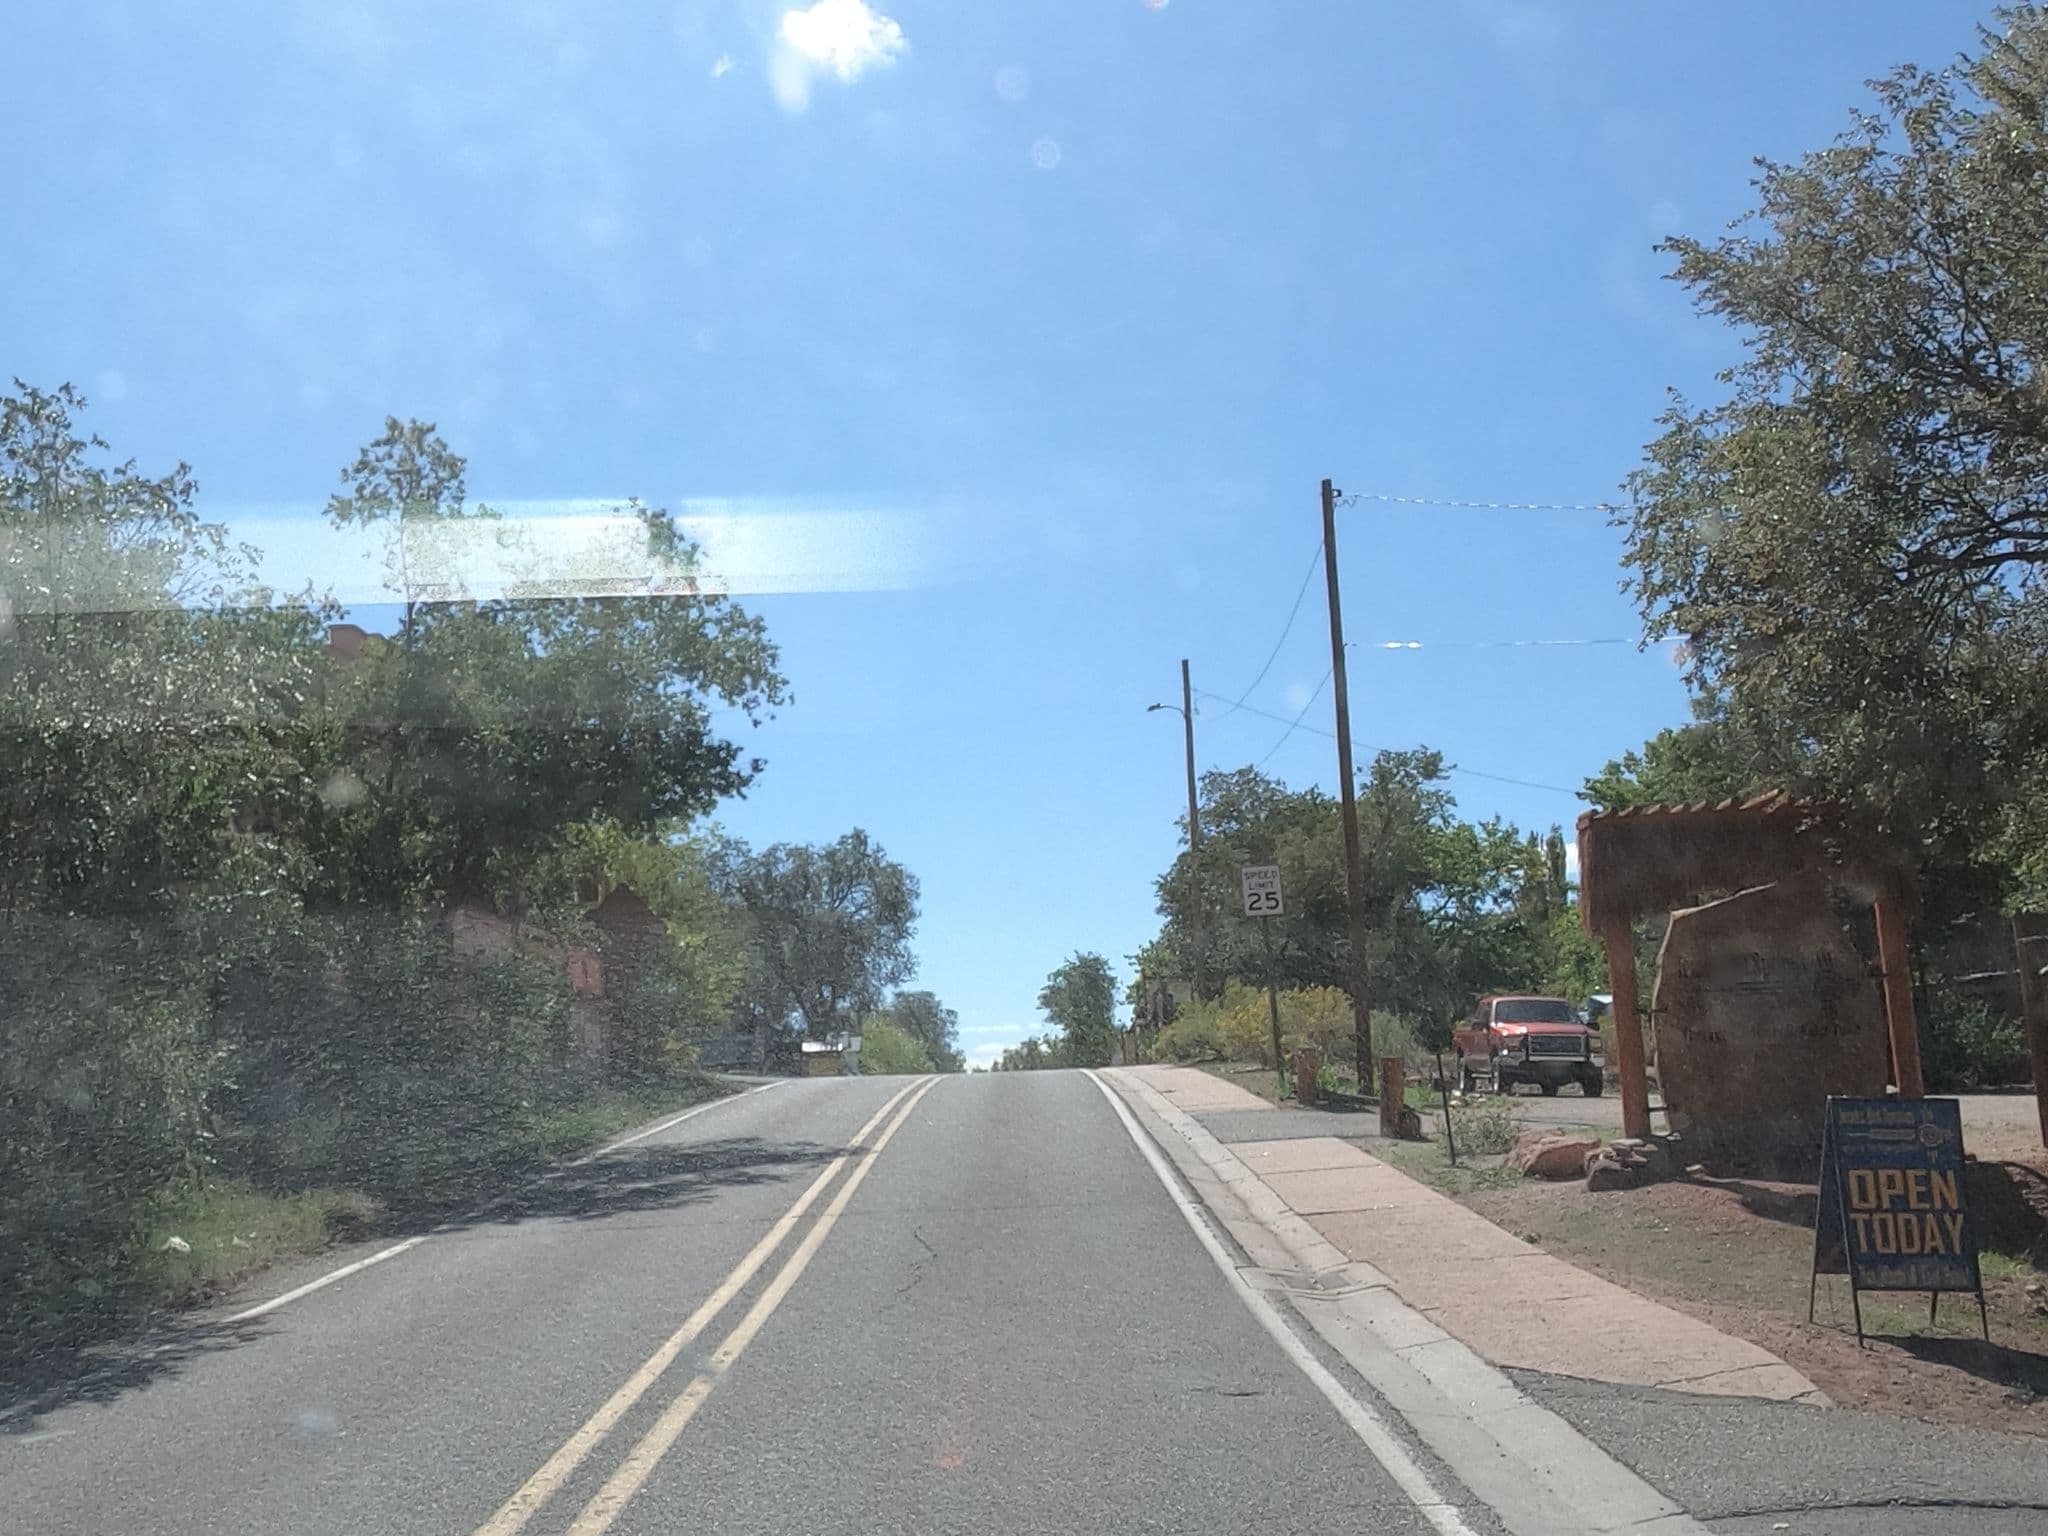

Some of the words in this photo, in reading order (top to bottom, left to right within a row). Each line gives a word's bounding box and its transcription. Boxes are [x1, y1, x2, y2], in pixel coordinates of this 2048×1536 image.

[1244, 870, 1278, 880] SPEED
[1248, 880, 1274, 890] LIMIT
[1248, 891, 1279, 911] 25
[1848, 1169, 1959, 1209] OPEN
[1850, 1213, 1964, 1254] TODAY
